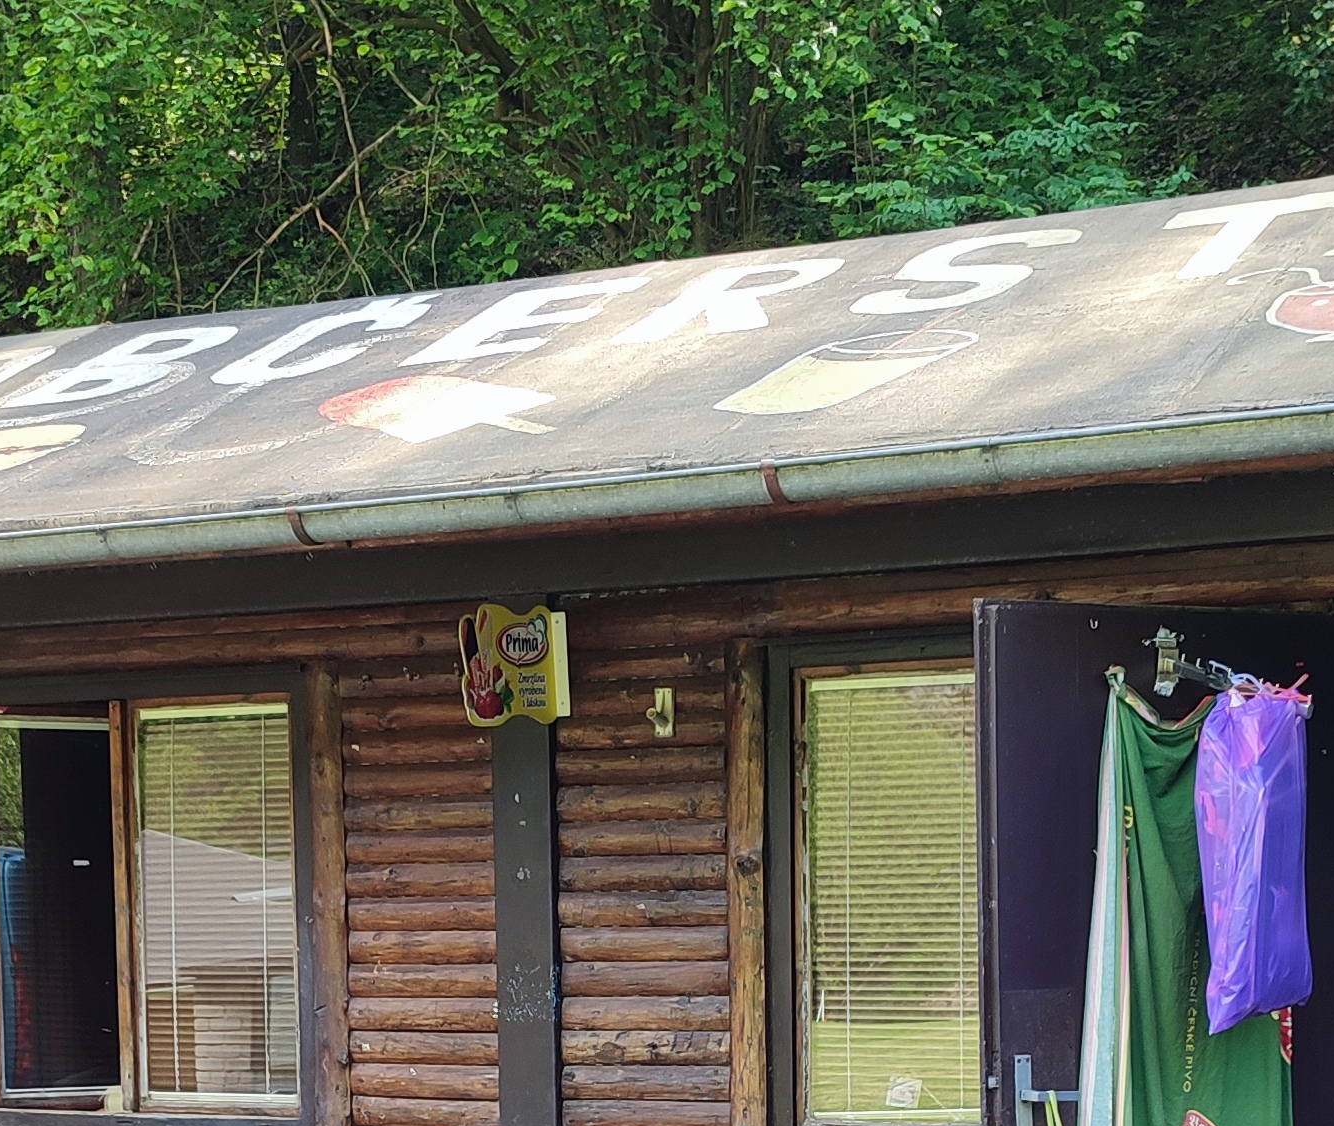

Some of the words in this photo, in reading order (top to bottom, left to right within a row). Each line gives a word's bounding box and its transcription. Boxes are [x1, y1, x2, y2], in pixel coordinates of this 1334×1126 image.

[505, 632, 540, 653] Prima
[517, 672, 546, 685] Zmrzlina
[1182, 1055, 1194, 1094] PIVO
